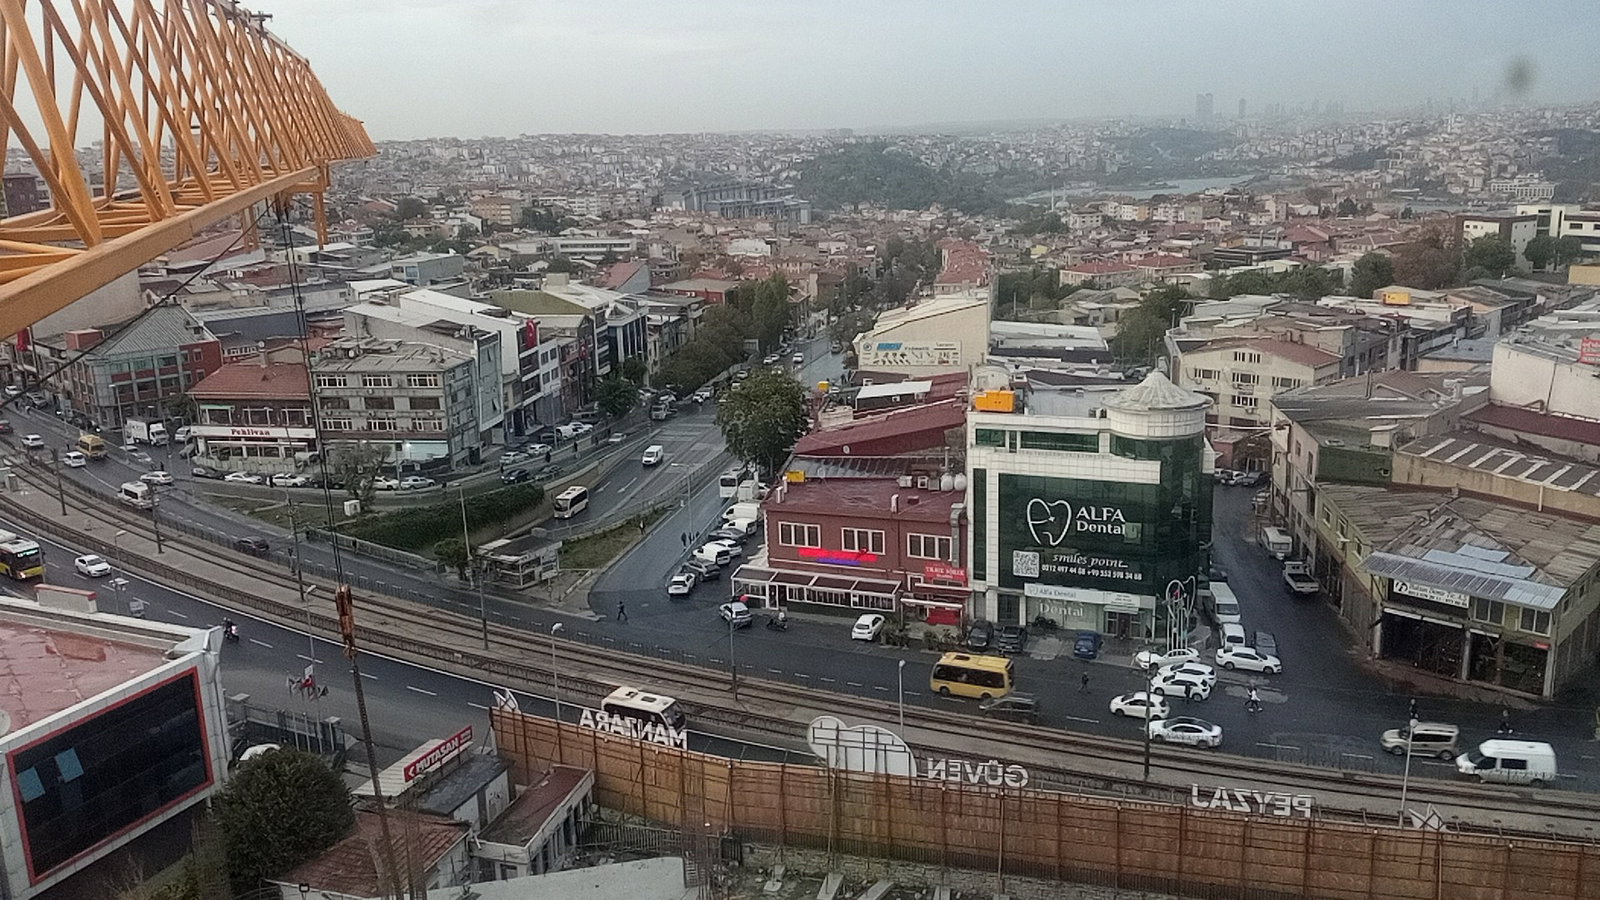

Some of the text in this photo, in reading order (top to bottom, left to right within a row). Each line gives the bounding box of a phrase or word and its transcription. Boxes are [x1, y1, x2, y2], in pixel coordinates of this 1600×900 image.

[1076, 506, 1125, 522] ALFA
[1076, 520, 1125, 535] Dental
[1053, 553, 1087, 565] smiles
[1040, 602, 1083, 617] Dental
